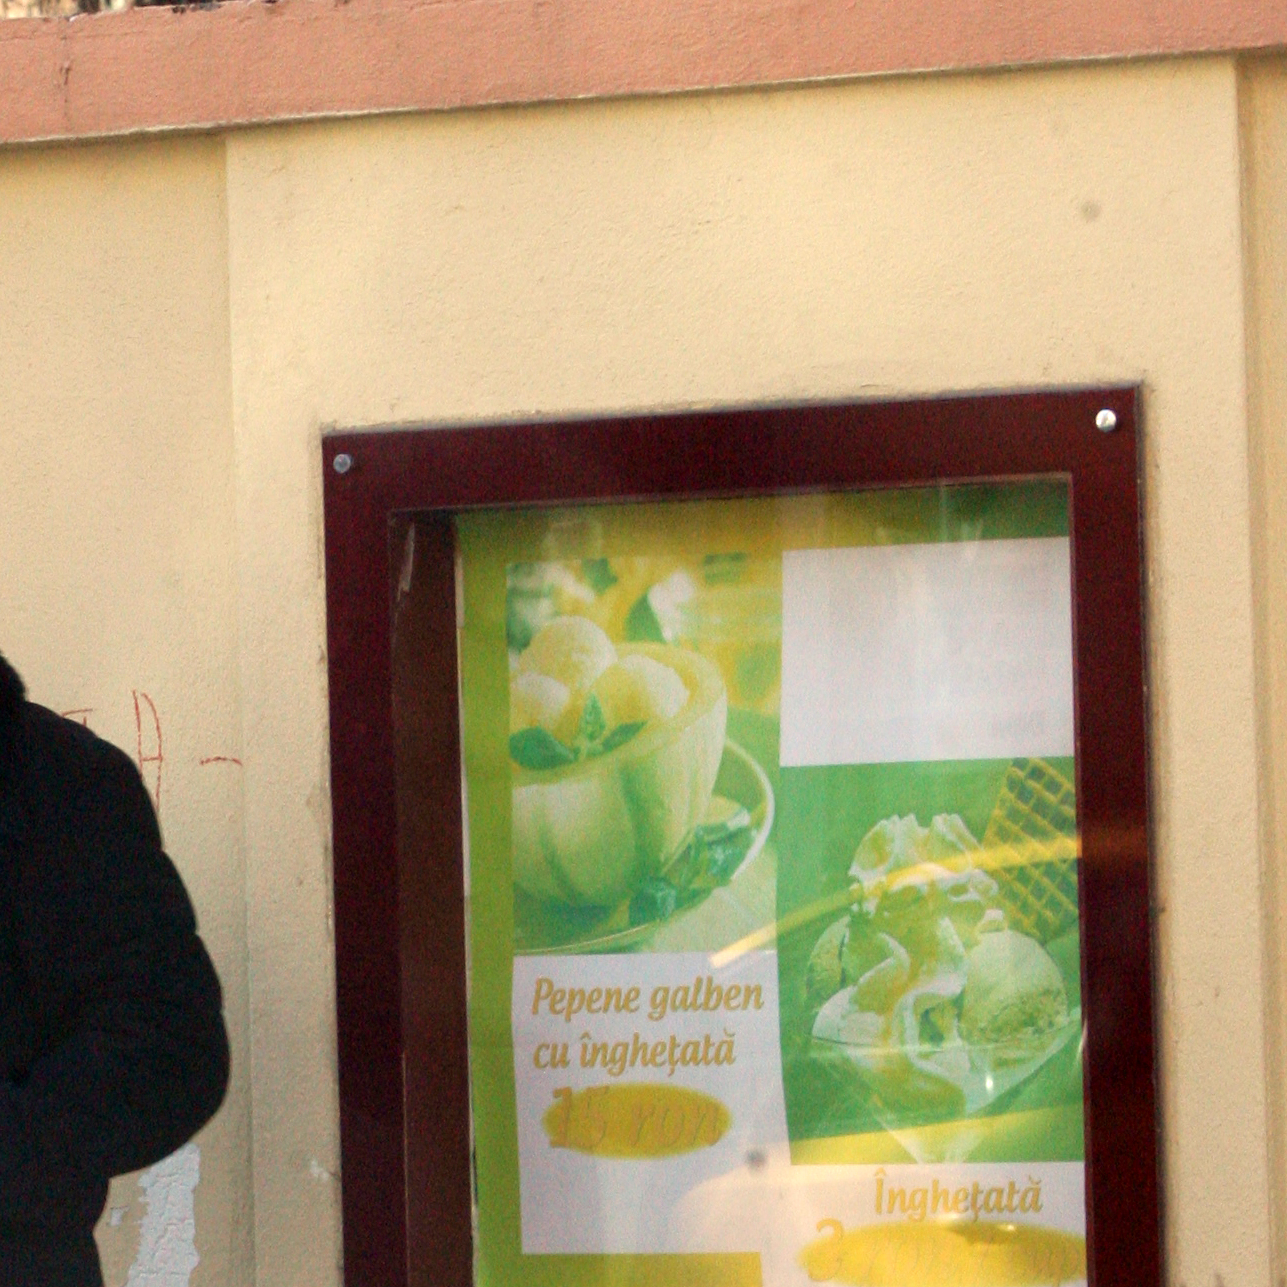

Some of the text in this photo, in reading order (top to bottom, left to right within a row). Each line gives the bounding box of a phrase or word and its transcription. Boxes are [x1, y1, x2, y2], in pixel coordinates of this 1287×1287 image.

[531, 975, 765, 1023] Pepene galben
[532, 1040, 571, 1070] cu
